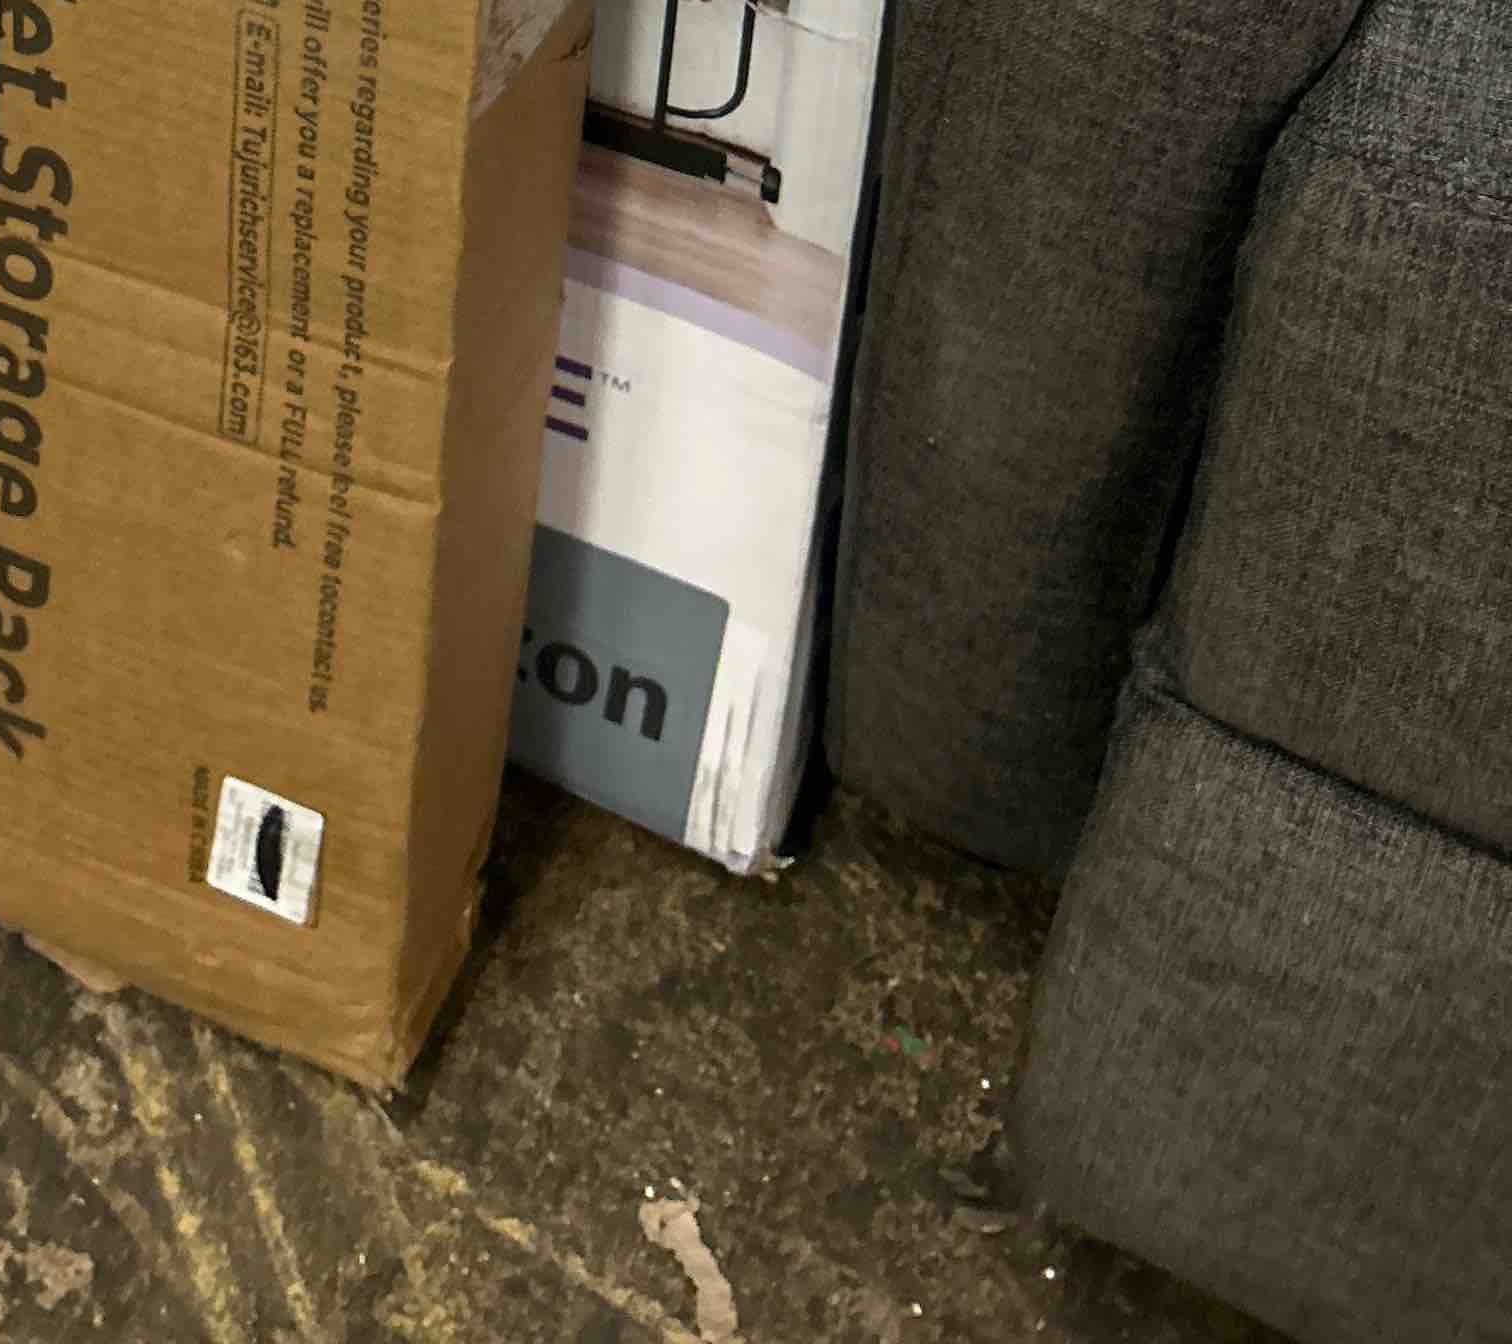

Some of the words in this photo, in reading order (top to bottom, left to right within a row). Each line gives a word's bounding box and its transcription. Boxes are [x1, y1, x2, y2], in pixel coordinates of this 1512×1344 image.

[242, 20, 272, 117] E-mail:
[298, 36, 329, 104] offer
[294, 106, 321, 158] you
[347, 74, 382, 207] regarding
[295, 164, 317, 181] a
[288, 184, 319, 340] replacement
[344, 208, 372, 271] your
[334, 274, 369, 380] product,
[284, 379, 303, 396] a
[288, 348, 306, 376] or
[279, 401, 307, 461] FULL
[331, 384, 361, 466] please
[271, 465, 300, 549] refund.
[326, 470, 355, 518] feel
[322, 520, 352, 567] free
